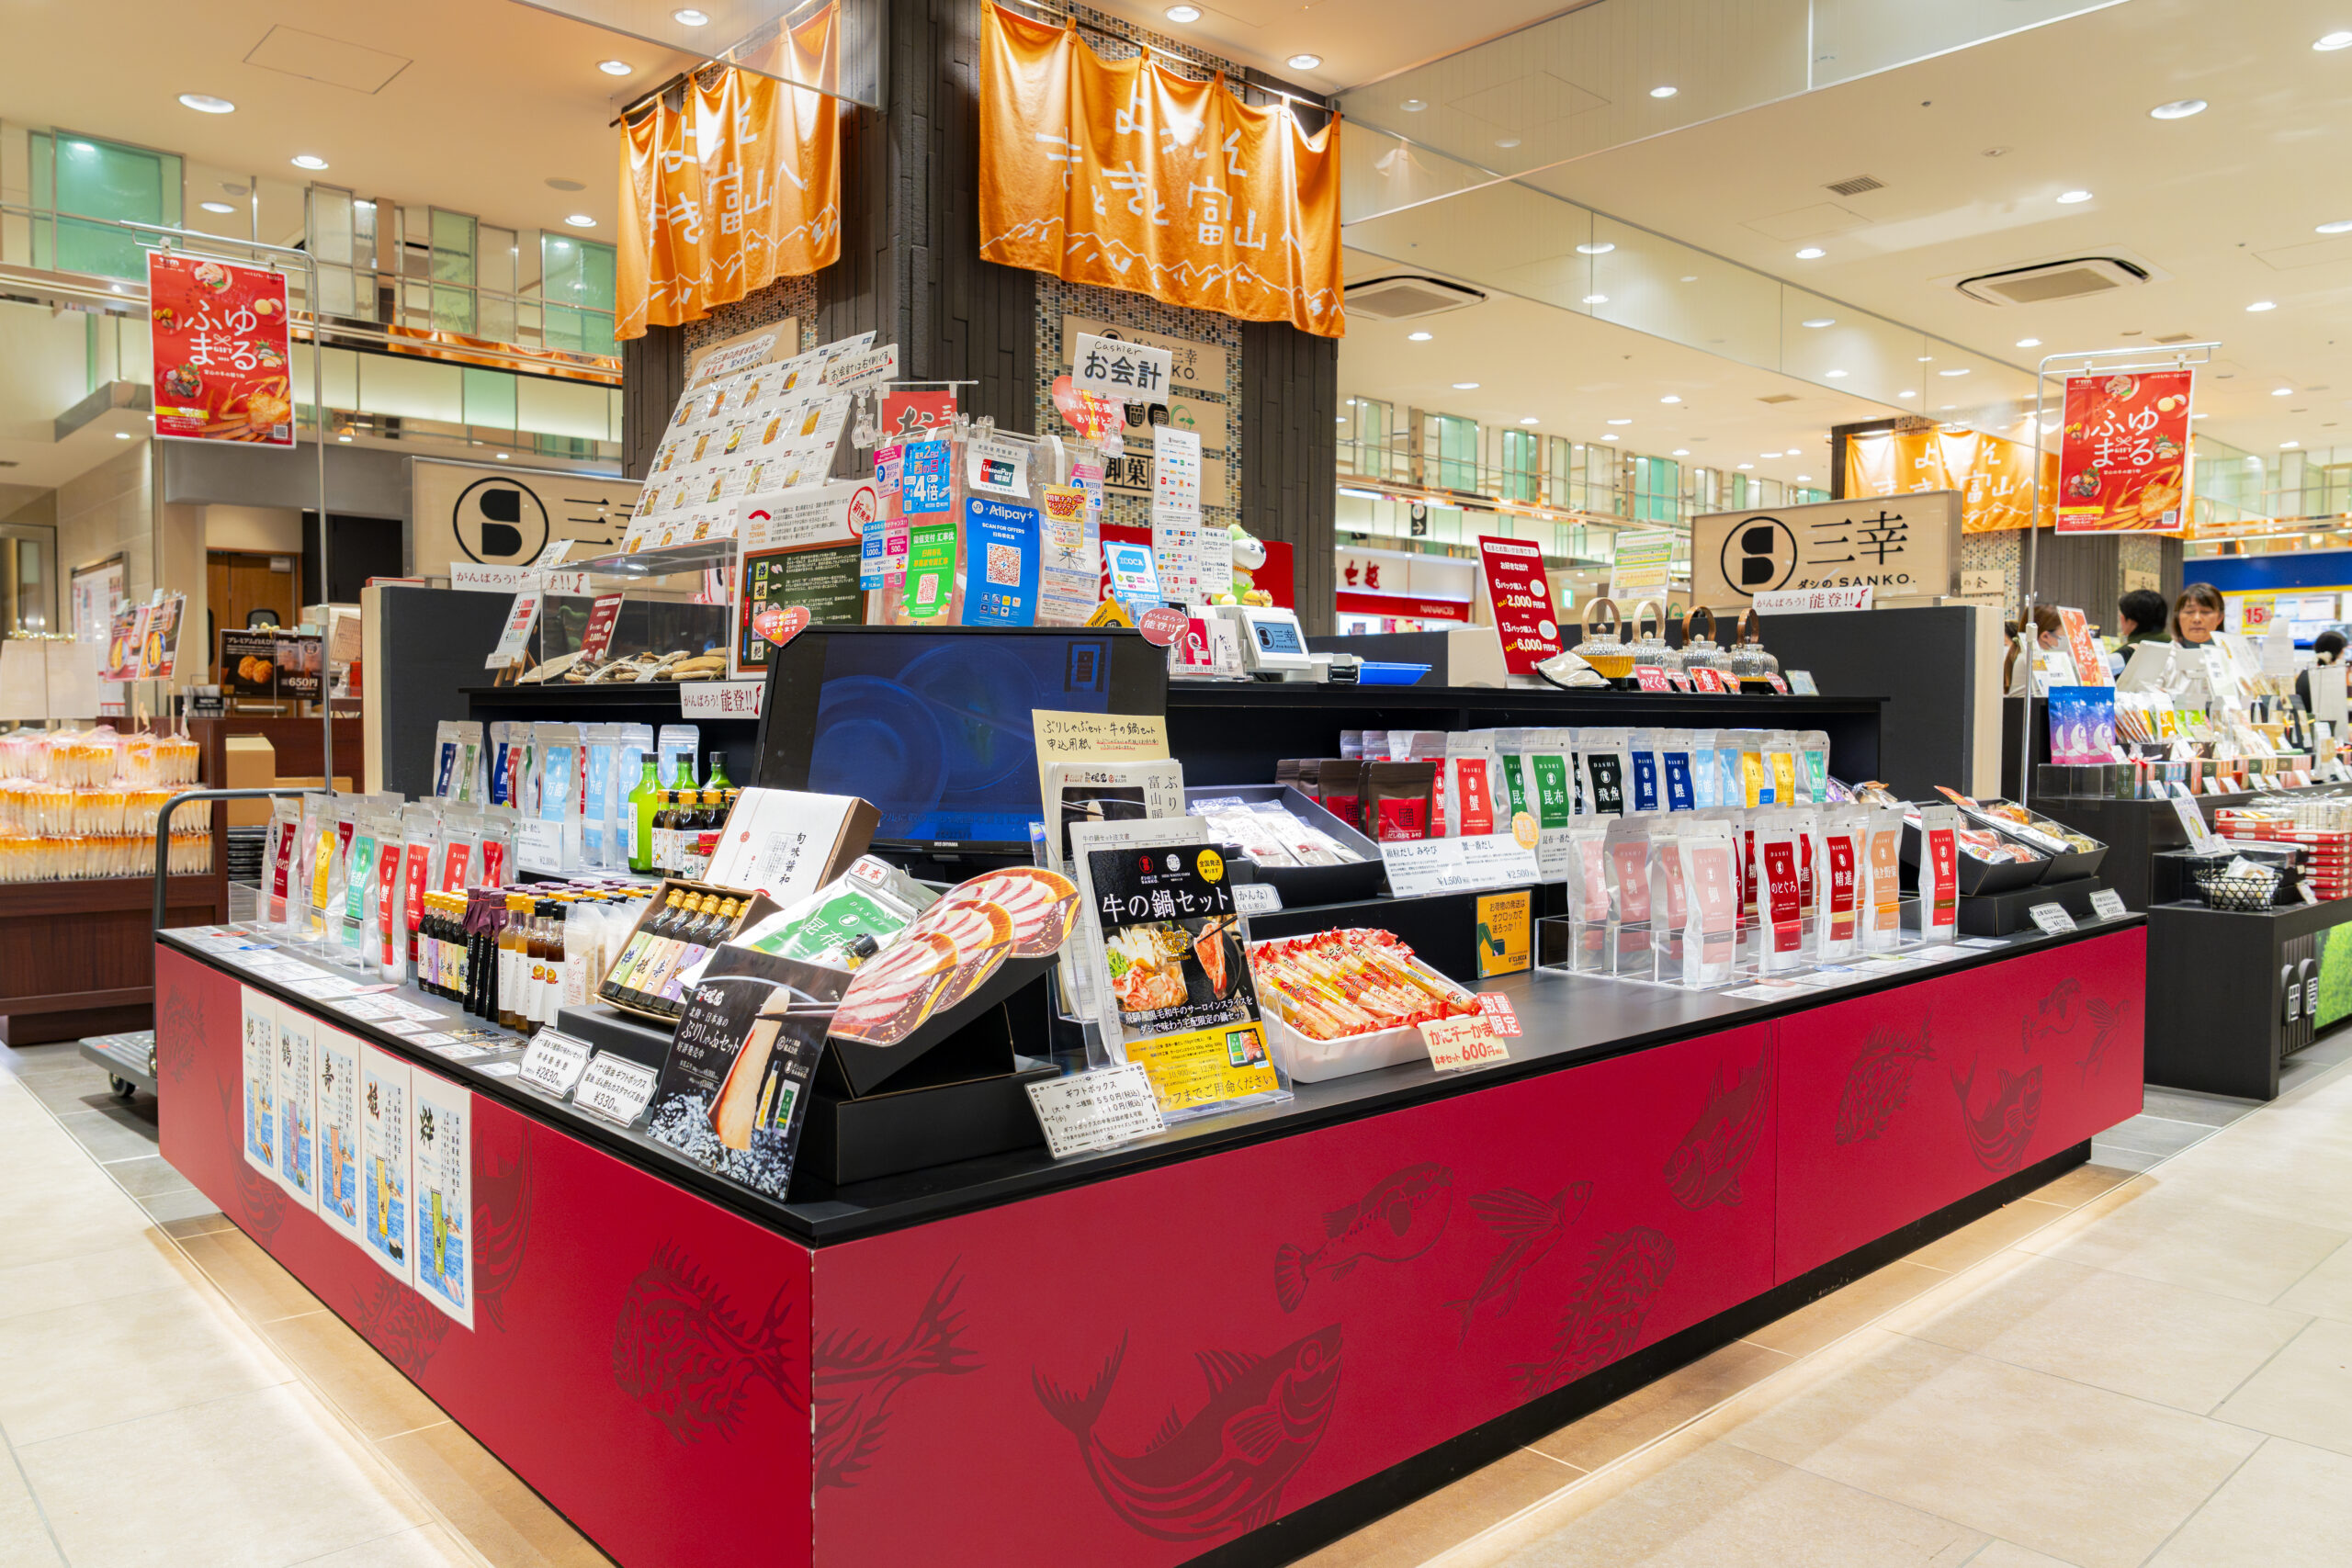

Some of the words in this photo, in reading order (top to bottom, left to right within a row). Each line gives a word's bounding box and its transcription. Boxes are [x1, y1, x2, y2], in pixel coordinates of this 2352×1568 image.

[184, 299, 257, 336] ふゆ
[189, 333, 257, 370] まる
[1094, 341, 1143, 355] Cashier
[1084, 351, 1162, 390] お会計
[2090, 406, 2159, 437] ふゆ
[2092, 438, 2154, 468] まる
[982, 464, 1013, 478] UnionPay
[989, 504, 1035, 523] Alipay+
[1807, 511, 1908, 565] 三幸
[456, 572, 516, 585] がんばろう!
[1798, 576, 1833, 591] ダシの
[1838, 573, 1917, 588] SANKO.
[1756, 597, 1806, 610] がんばろう!
[1808, 592, 1854, 610] 能登!!
[1147, 612, 1185, 624] がんばろう!
[2245, 606, 2264, 624] 15
[1143, 620, 1175, 633] 能登!!
[684, 694, 719, 707] がんばろう!
[720, 689, 752, 713] 能登!!
[1047, 738, 1091, 751] 申込用紙
[545, 783, 566, 797] 万能
[1164, 776, 1178, 811] ぶり
[1544, 789, 1565, 806] 昆布
[1598, 787, 1621, 802] 飛魚
[1417, 845, 1438, 856] みやび
[854, 862, 882, 881] 見本
[1199, 859, 1221, 867] 全国発送
[1834, 870, 1853, 887] 精進
[1102, 886, 1229, 922] 牛の鍋セット
[1489, 898, 1526, 912] お荷物の発送は
[1492, 909, 1523, 924] オクロッカで
[1480, 996, 1512, 1015] 数量
[1490, 1016, 1521, 1035] 限定
[536, 1066, 559, 1084] ¥2830
[1066, 1081, 1117, 1098] ギフトボックス
[593, 1091, 616, 1110] ¥330
